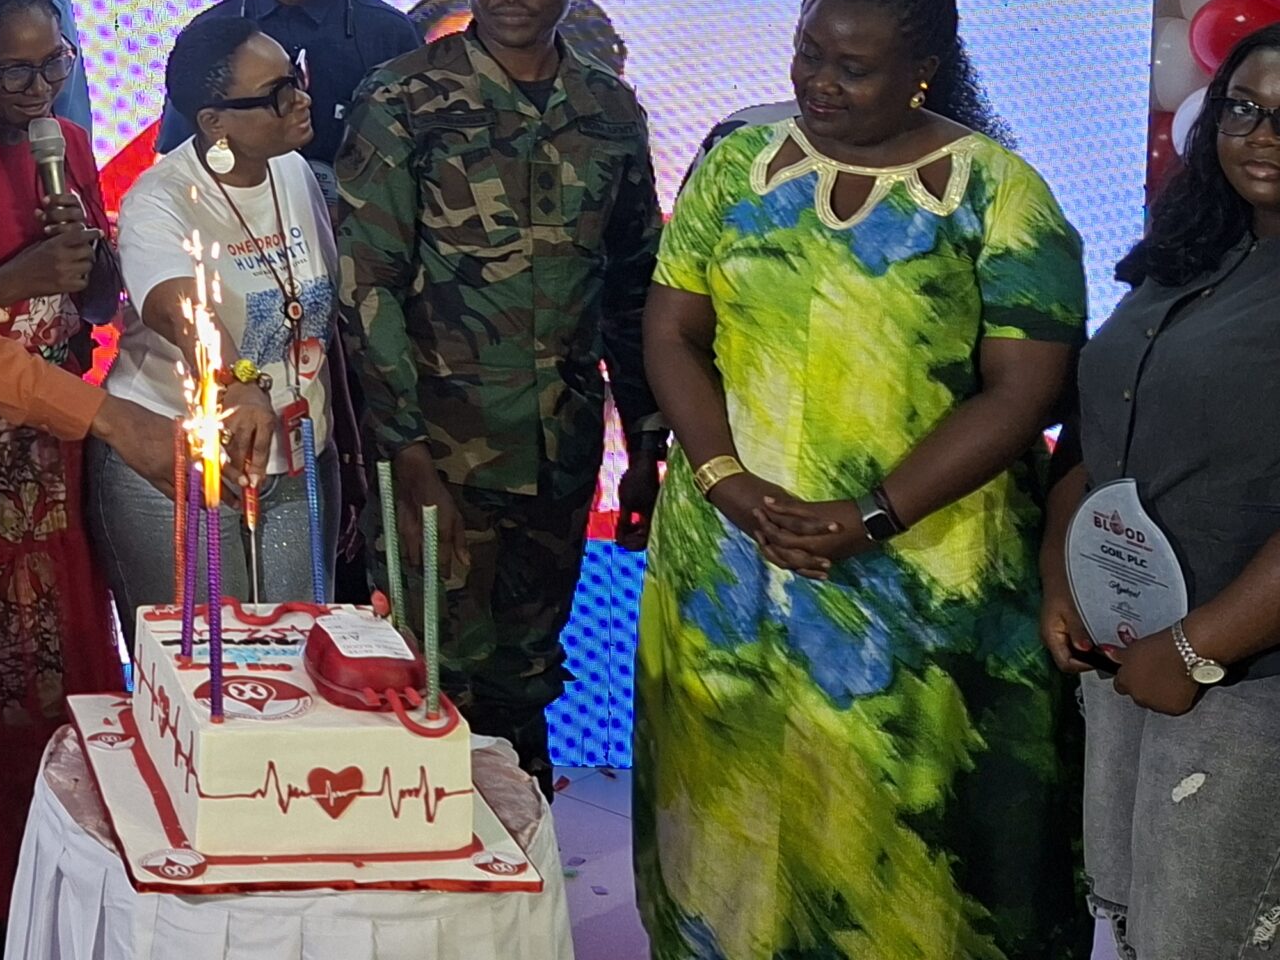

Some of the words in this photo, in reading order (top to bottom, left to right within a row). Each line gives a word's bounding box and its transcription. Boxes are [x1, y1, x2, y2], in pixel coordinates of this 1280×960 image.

[227, 240, 253, 256] ONE
[234, 241, 308, 271] HUMANIT
[1093, 511, 1146, 543] BLOOD
[1127, 554, 1148, 569] PLC
